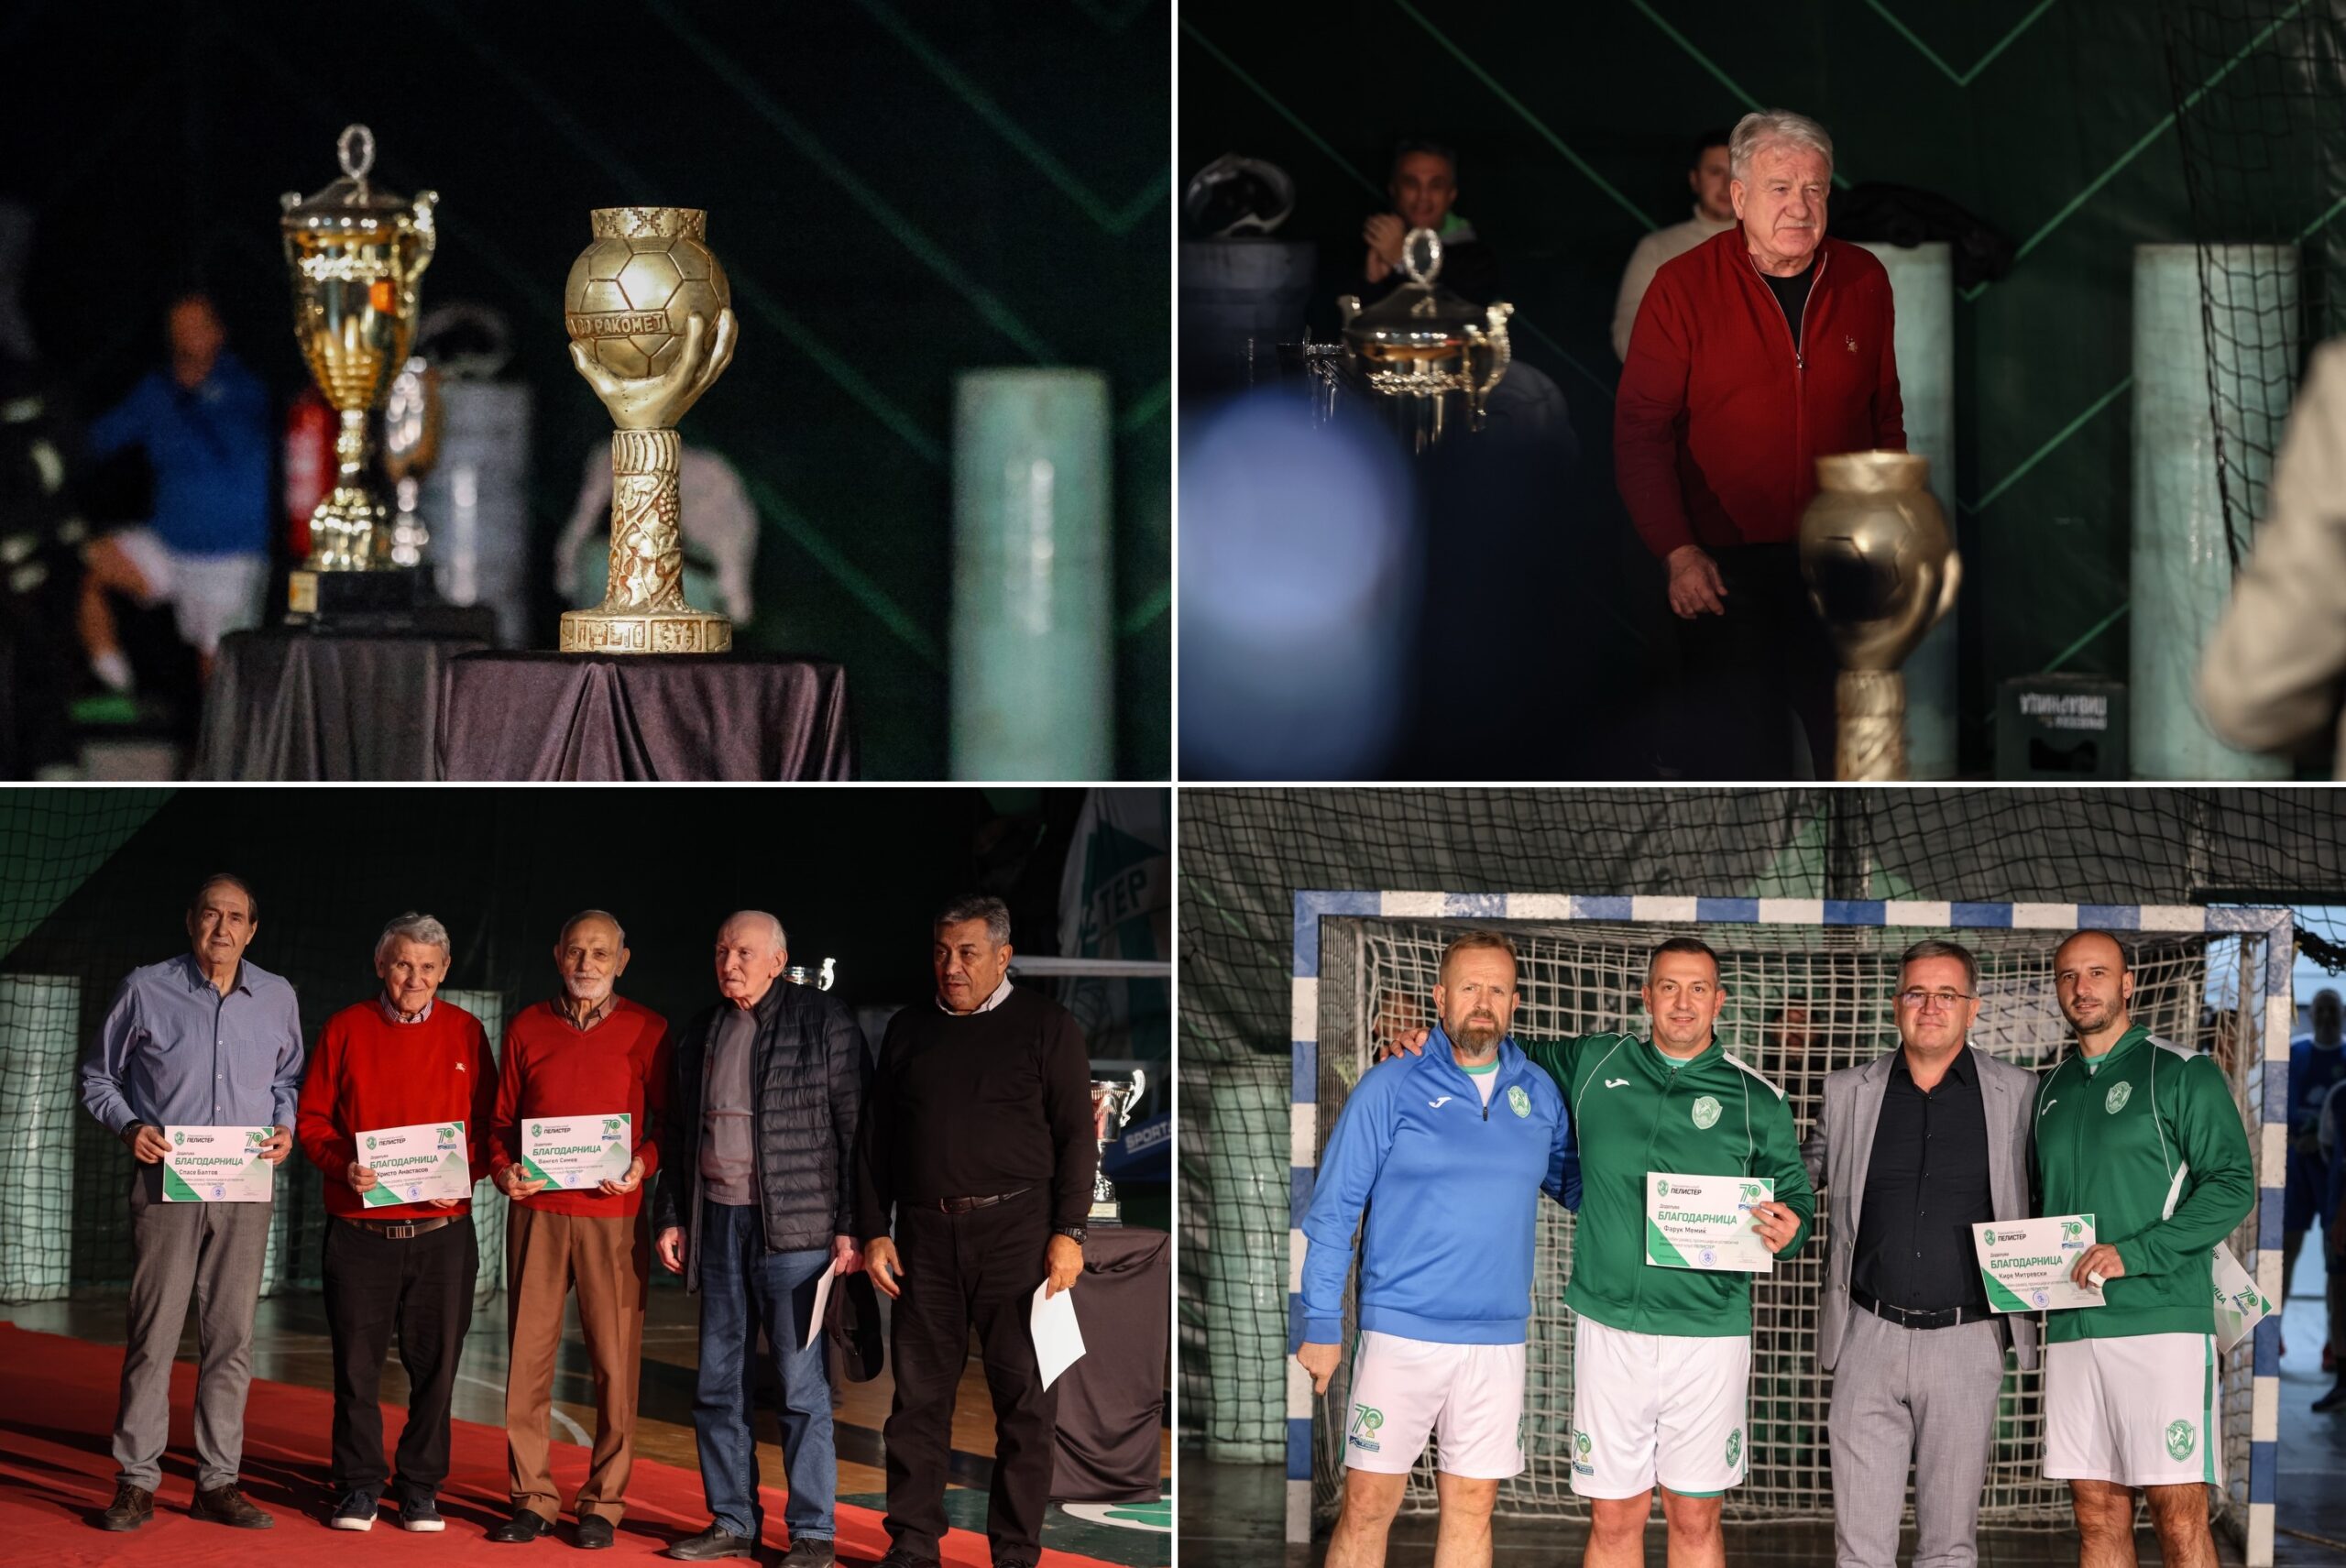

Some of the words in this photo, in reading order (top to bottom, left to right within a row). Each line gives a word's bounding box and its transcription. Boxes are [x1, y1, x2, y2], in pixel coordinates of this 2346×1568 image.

[594, 314, 663, 335] РАКОМЕТ
[378, 1138, 406, 1146] ПЕЛИСТЕР
[532, 1145, 601, 1157] БЛАГОДАРНИЦА
[175, 1157, 243, 1166] БЛАГОДАРНИЦА
[370, 1155, 438, 1169] БЛАГОДАРНИЦА
[1658, 1211, 1738, 1225] БЛАГОДАРНИЦА
[1663, 1224, 1683, 1234] Фарук
[1998, 1234, 2026, 1243] ПЕЛИСТЕР
[1990, 1255, 2063, 1269] БЛАГОДАРНИЦА
[2014, 1270, 2047, 1278] Митревски
